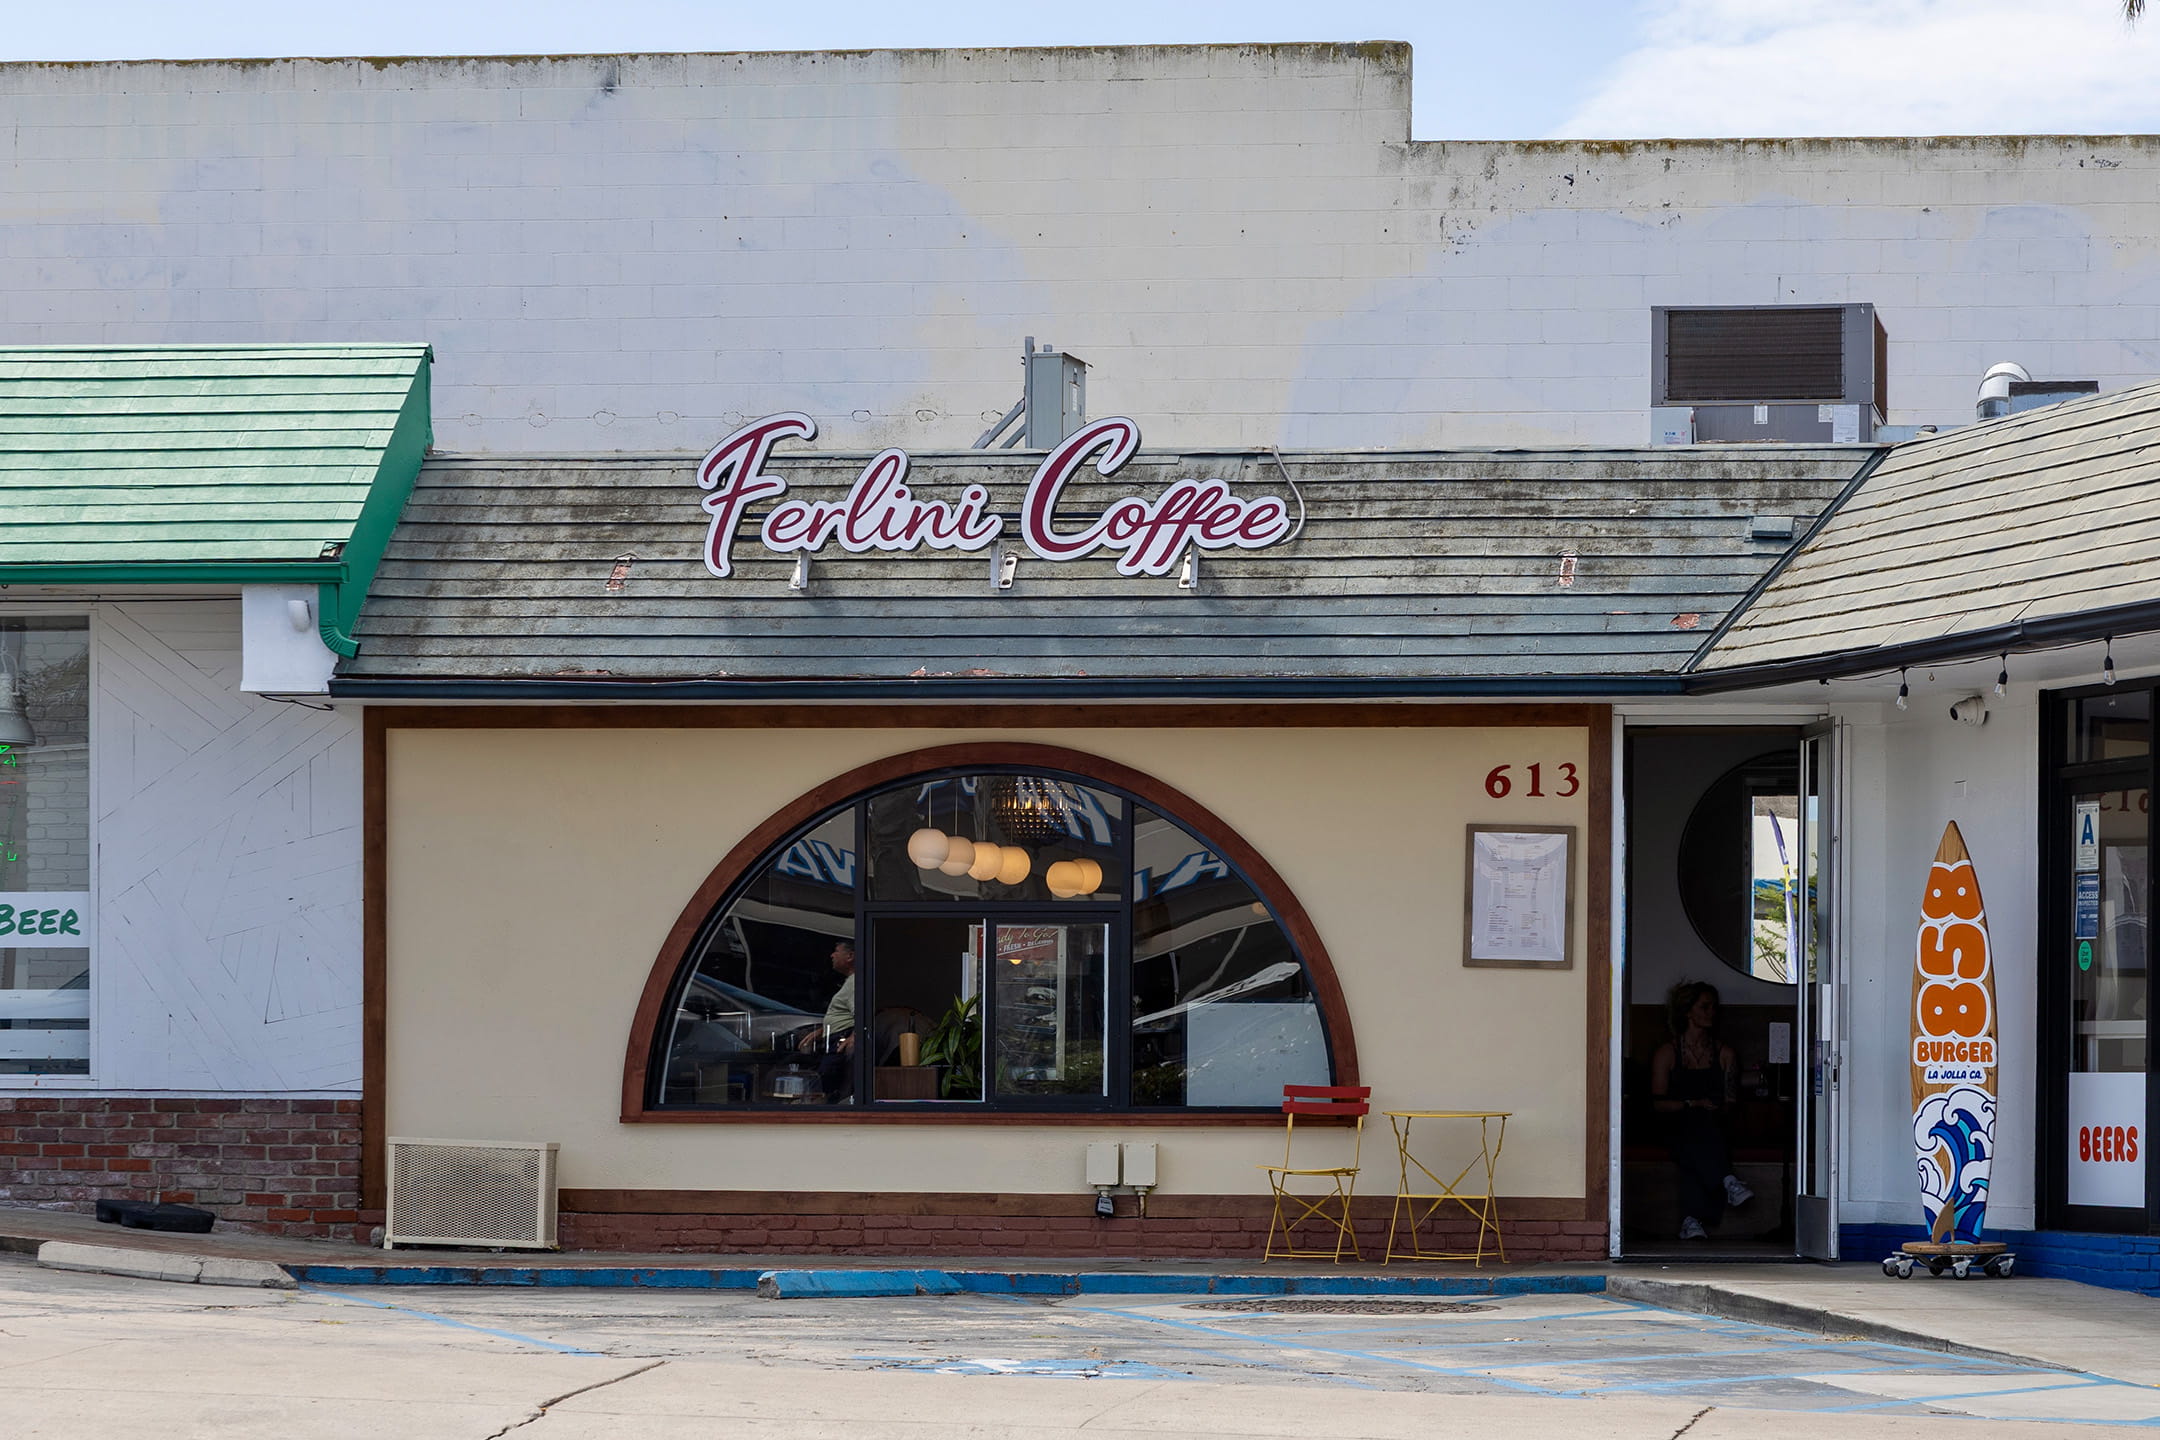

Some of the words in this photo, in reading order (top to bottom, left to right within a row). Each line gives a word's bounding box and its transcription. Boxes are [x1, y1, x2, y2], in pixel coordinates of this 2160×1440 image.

[699, 415, 999, 574] Ferlini
[1025, 419, 1287, 571] Coffee
[1484, 761, 1580, 799] 613
[2081, 814, 2095, 845] A
[2078, 890, 2098, 899] ACCESS
[1917, 1041, 1993, 1062] BURGER
[1928, 1070, 1939, 1079] LA
[1940, 1070, 1967, 1079] JOLLA
[2079, 1126, 2138, 1163] BEERS
